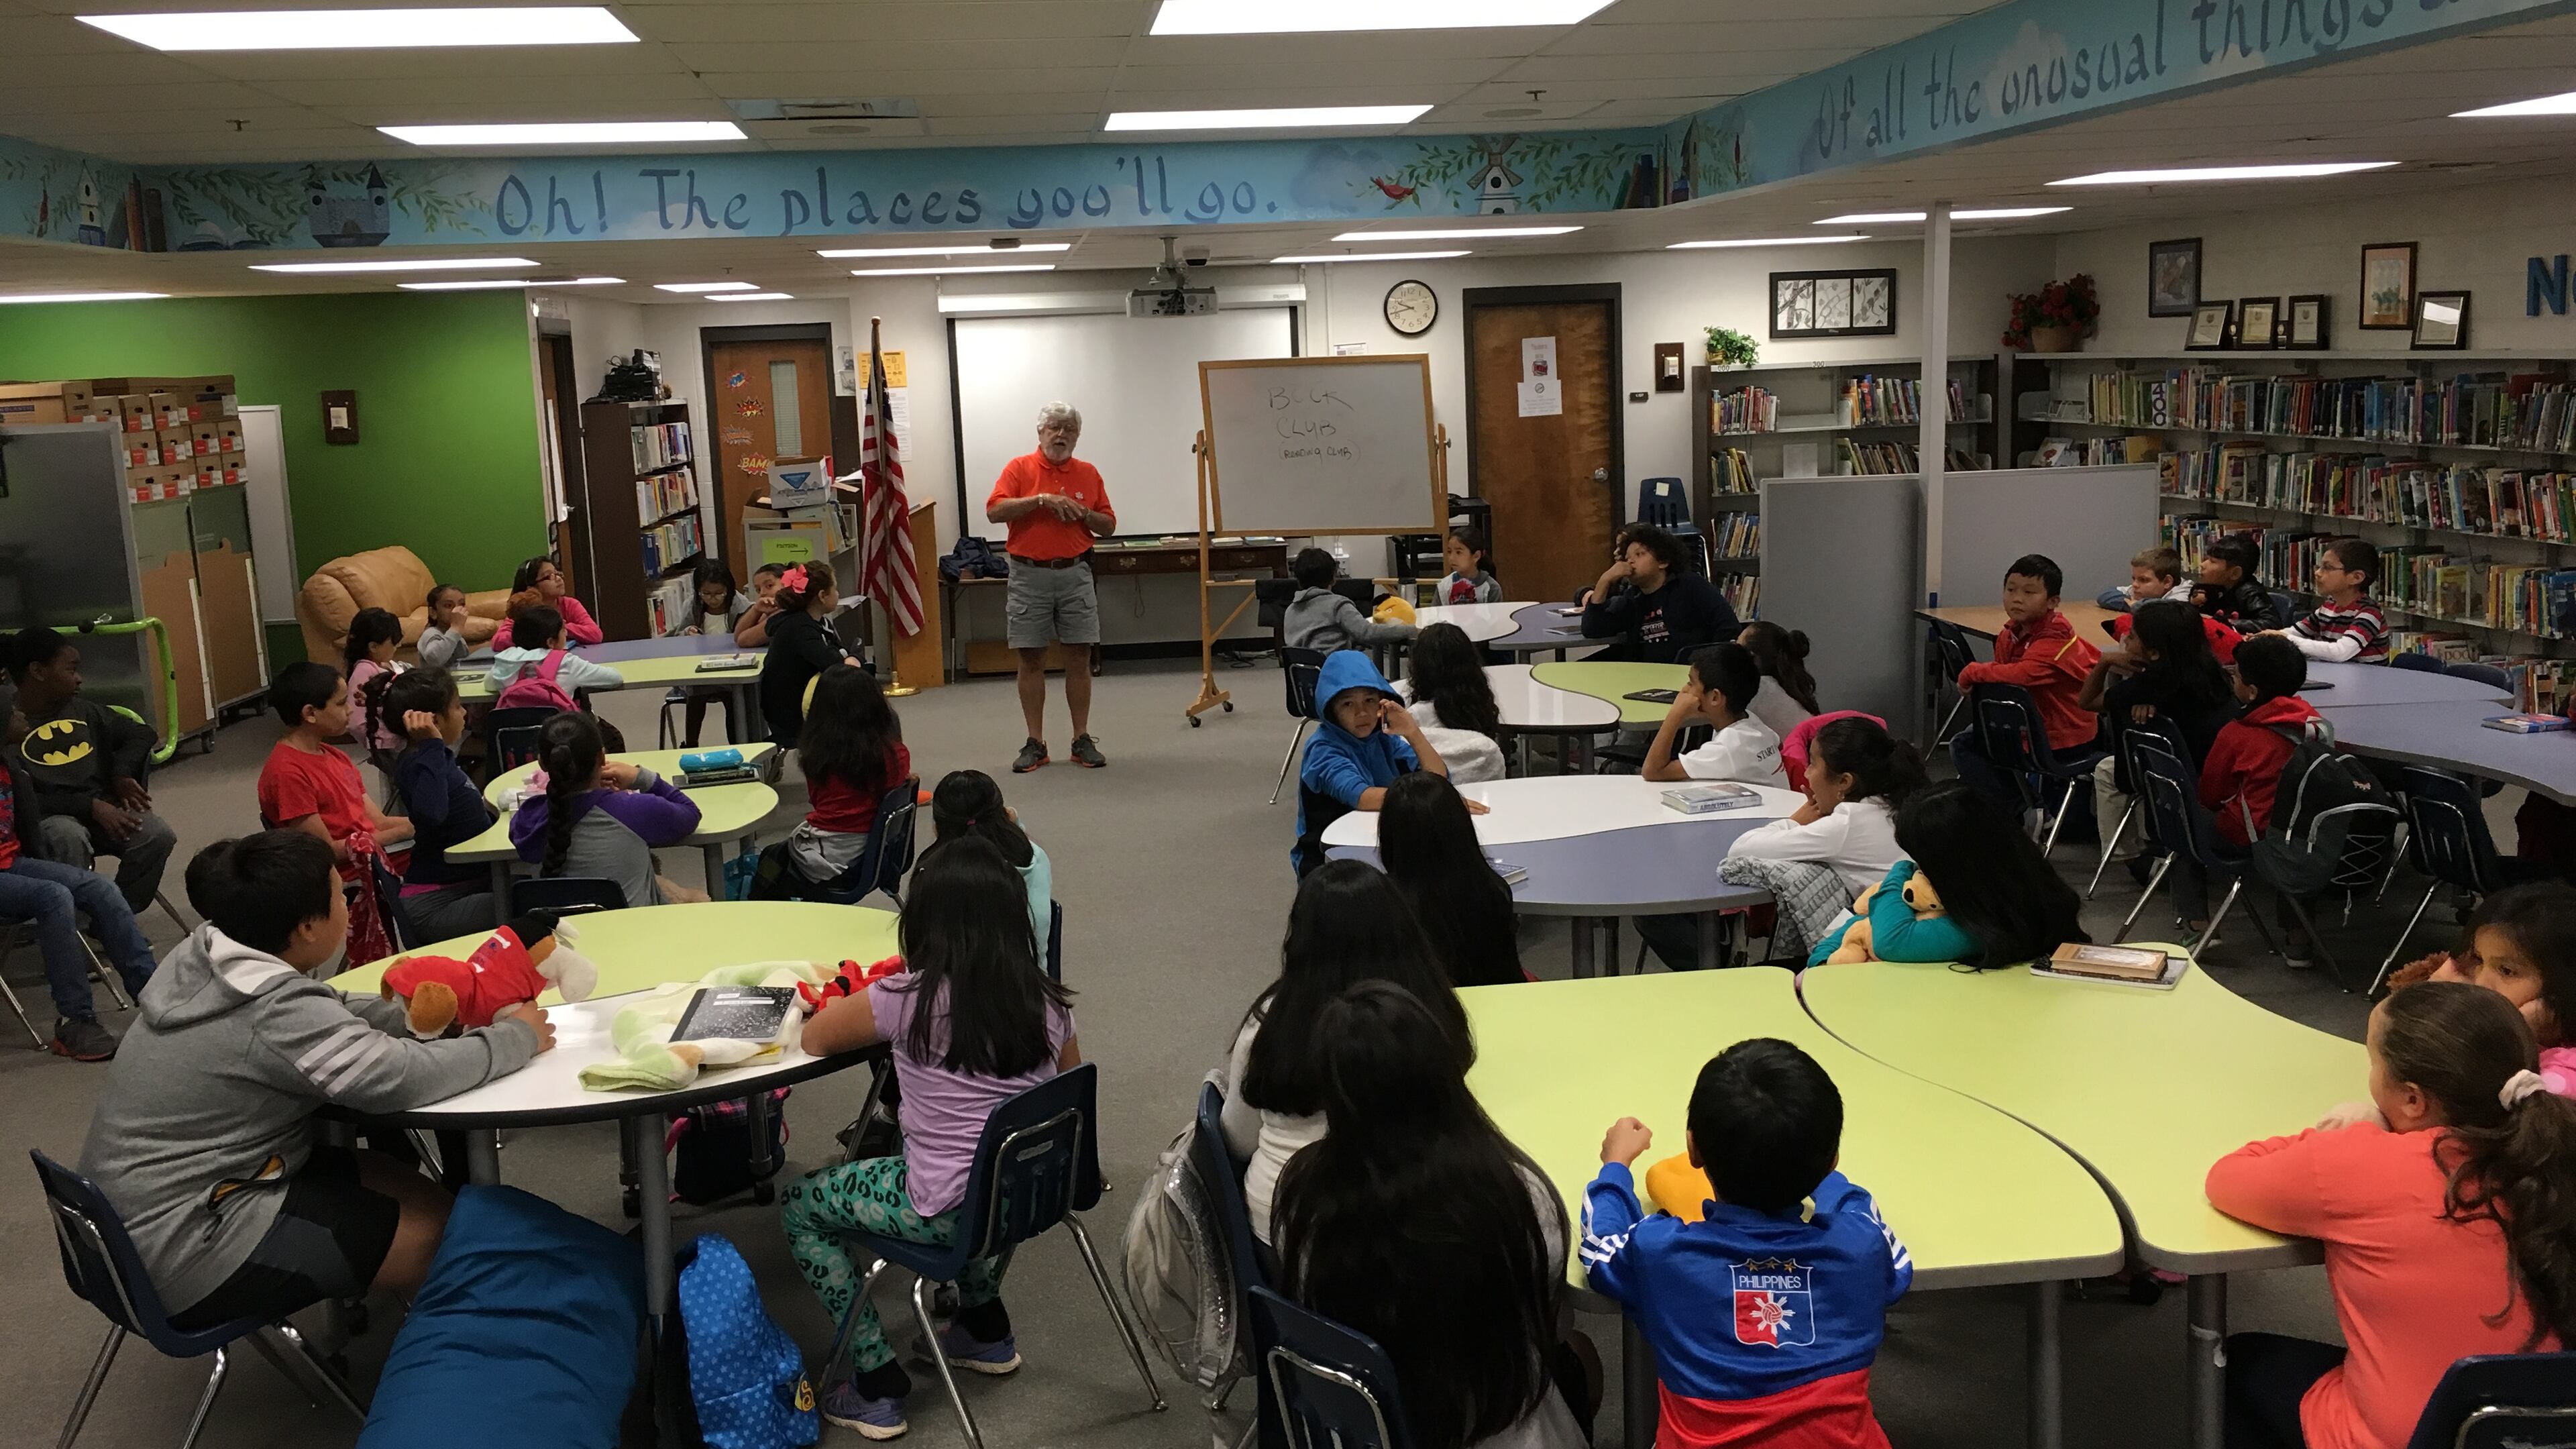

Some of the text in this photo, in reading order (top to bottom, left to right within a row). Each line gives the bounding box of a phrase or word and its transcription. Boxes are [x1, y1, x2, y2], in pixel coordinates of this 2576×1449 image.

[1817, 74, 1857, 160] Of
[1866, 60, 1907, 148] all
[1923, 44, 1982, 131] the
[2000, 0, 2167, 115] unusual
[496, 155, 1279, 236] Oh! The places you'll go.
[2526, 254, 2576, 317] N
[2151, 381, 2167, 427] 400
[1699, 801, 1734, 812] ABSOLUTELY
[1738, 1275, 1802, 1289] PHILIPPINES
